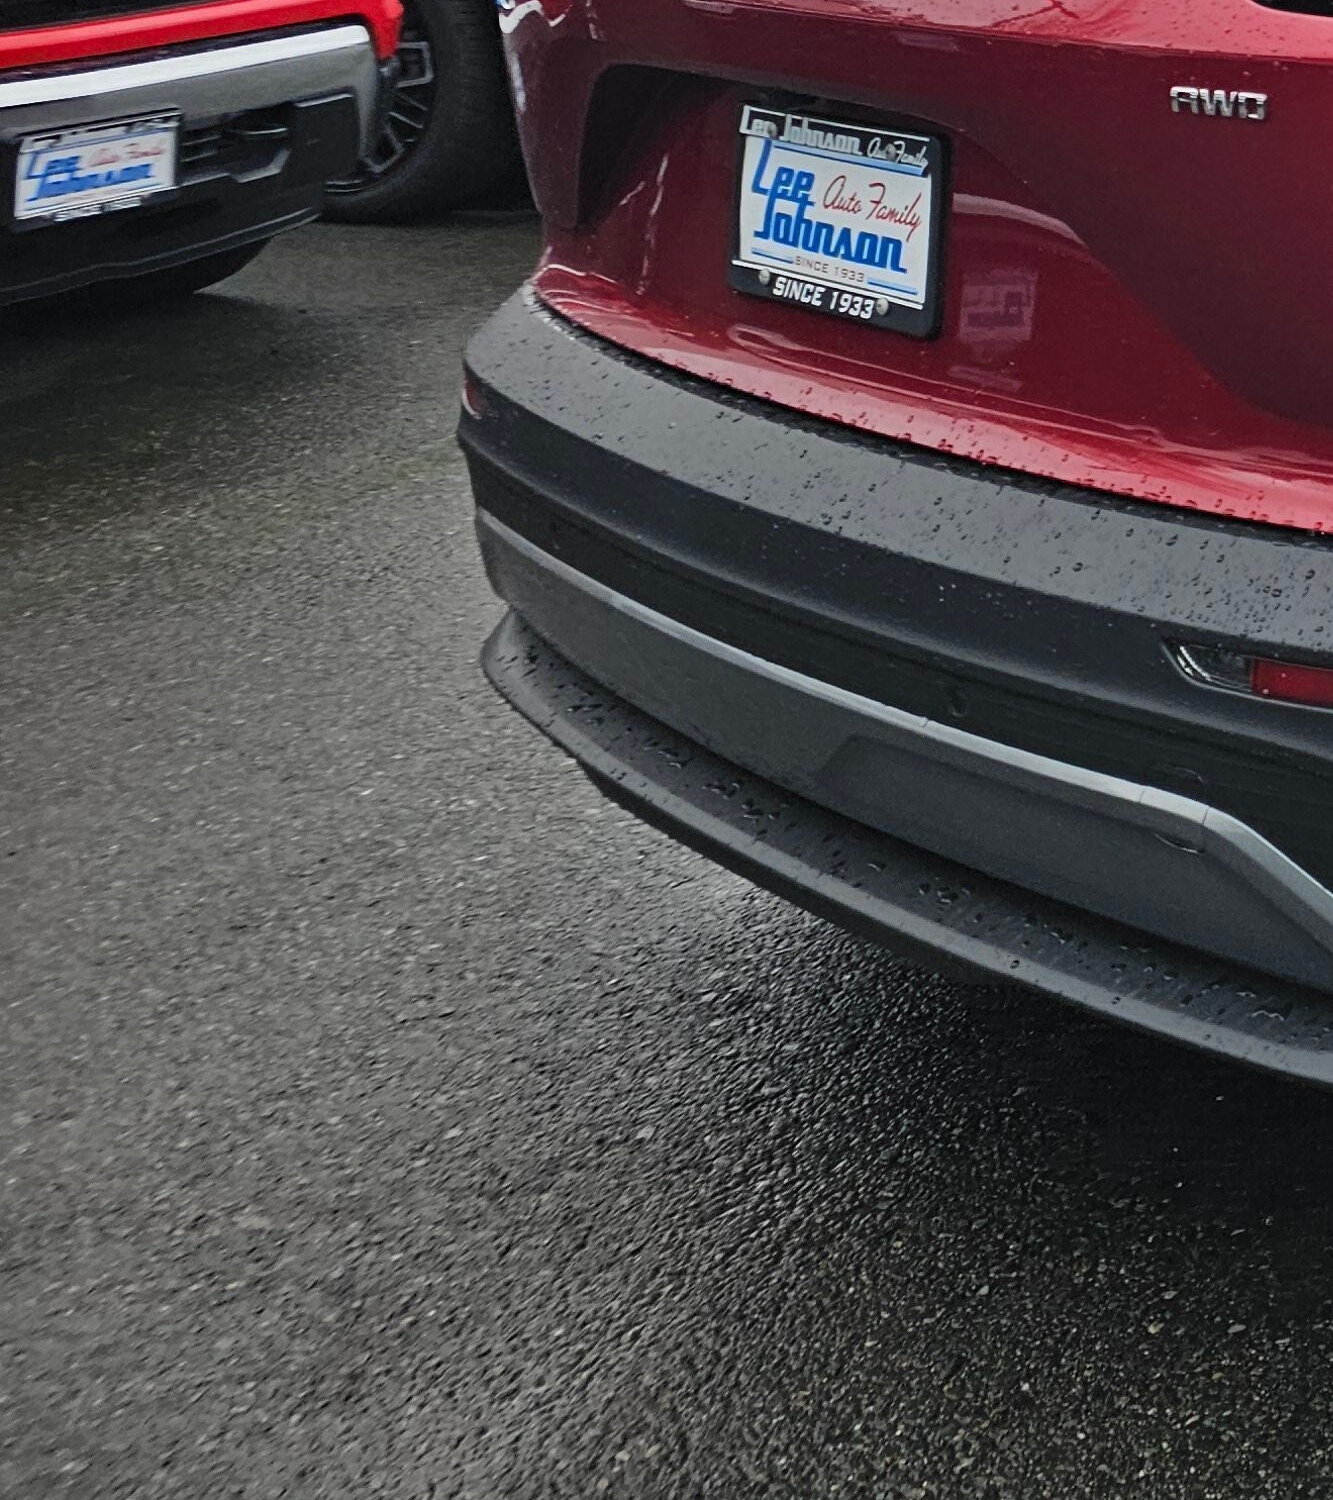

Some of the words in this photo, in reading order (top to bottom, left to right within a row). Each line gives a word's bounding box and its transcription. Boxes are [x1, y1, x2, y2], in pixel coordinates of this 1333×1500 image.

[1170, 86, 1268, 120] AWD
[739, 105, 778, 138] Lee
[779, 113, 863, 156] Johnson
[867, 137, 898, 162] Au
[894, 140, 929, 175] Family
[751, 138, 815, 202] Lee
[753, 199, 907, 274] Johnson
[822, 174, 863, 215] Auto
[865, 181, 923, 243] Family
[772, 276, 826, 308] SINCE
[829, 290, 875, 320] 1933
[794, 255, 829, 275] SINCE
[833, 266, 865, 283] 1933
